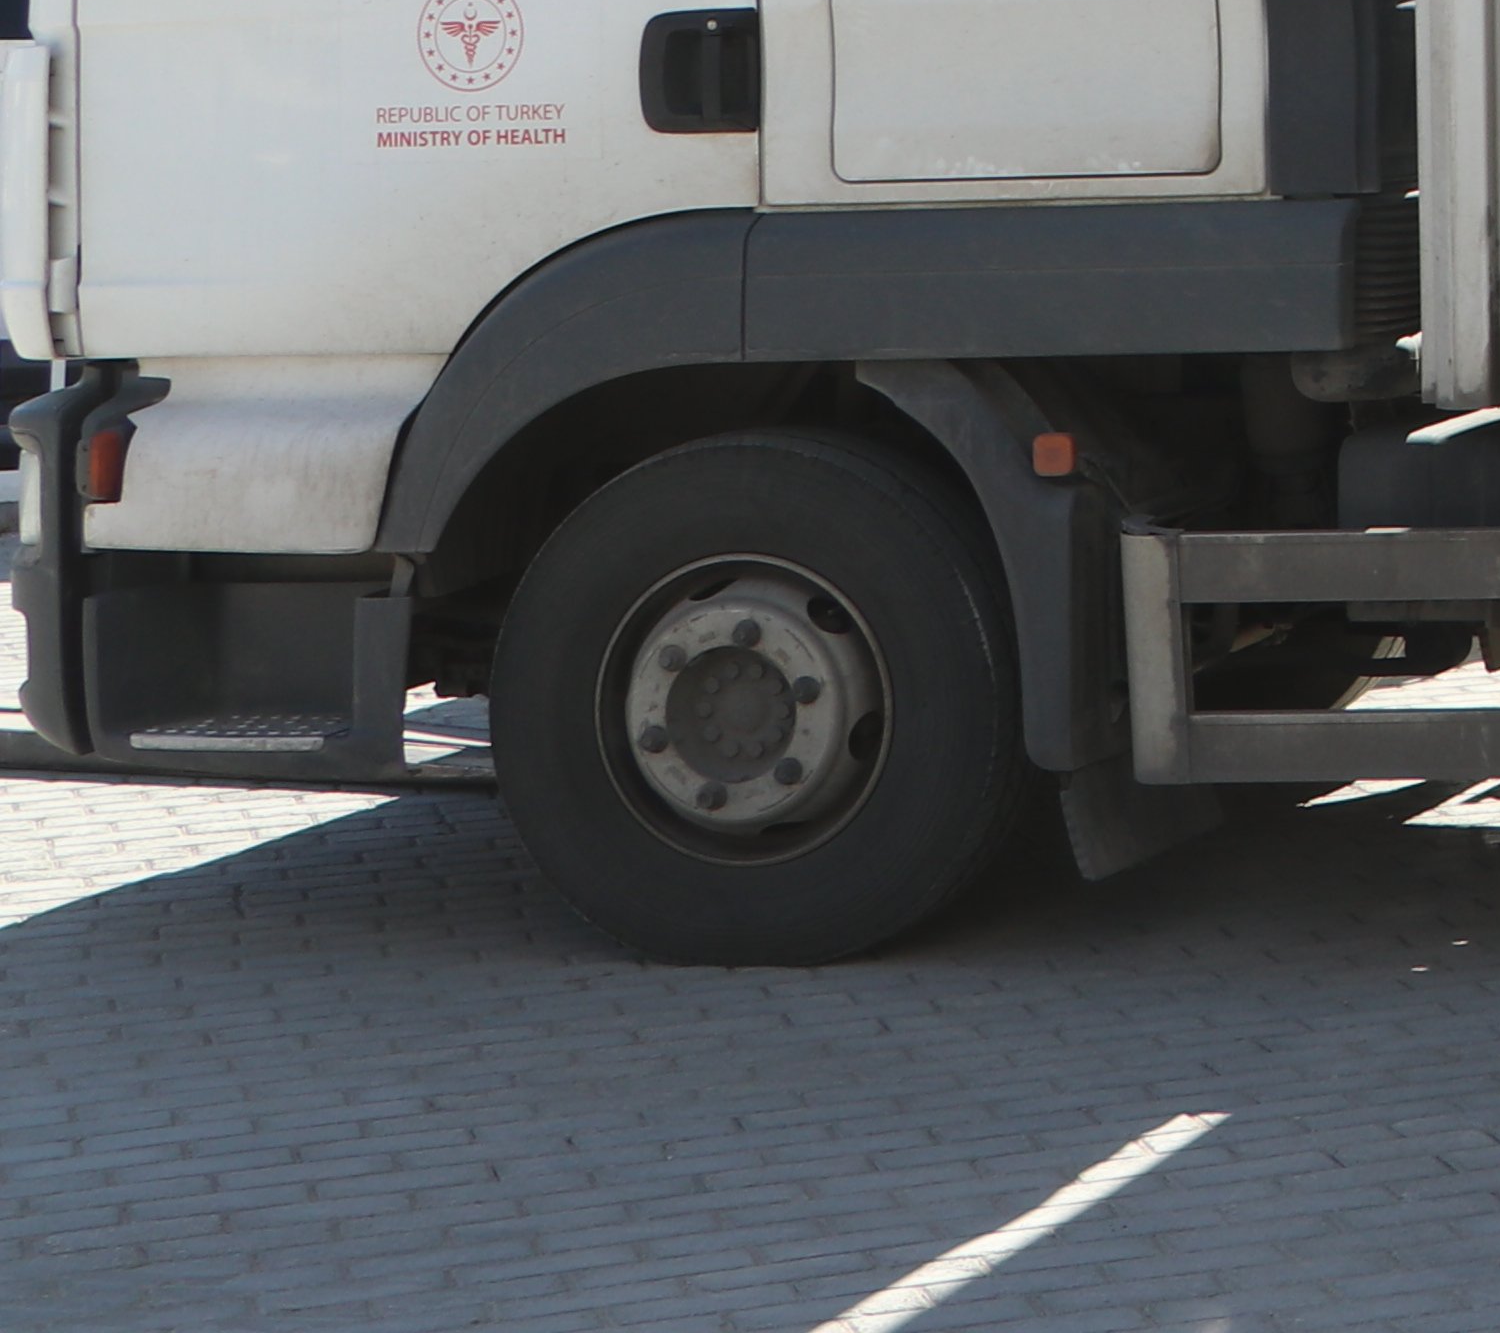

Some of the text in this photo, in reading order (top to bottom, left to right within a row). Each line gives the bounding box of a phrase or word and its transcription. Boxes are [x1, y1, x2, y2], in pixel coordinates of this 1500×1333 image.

[376, 103, 566, 124] REPUBLIC OF TURKEY
[376, 128, 566, 148] MINISTRY OF HEALTH
